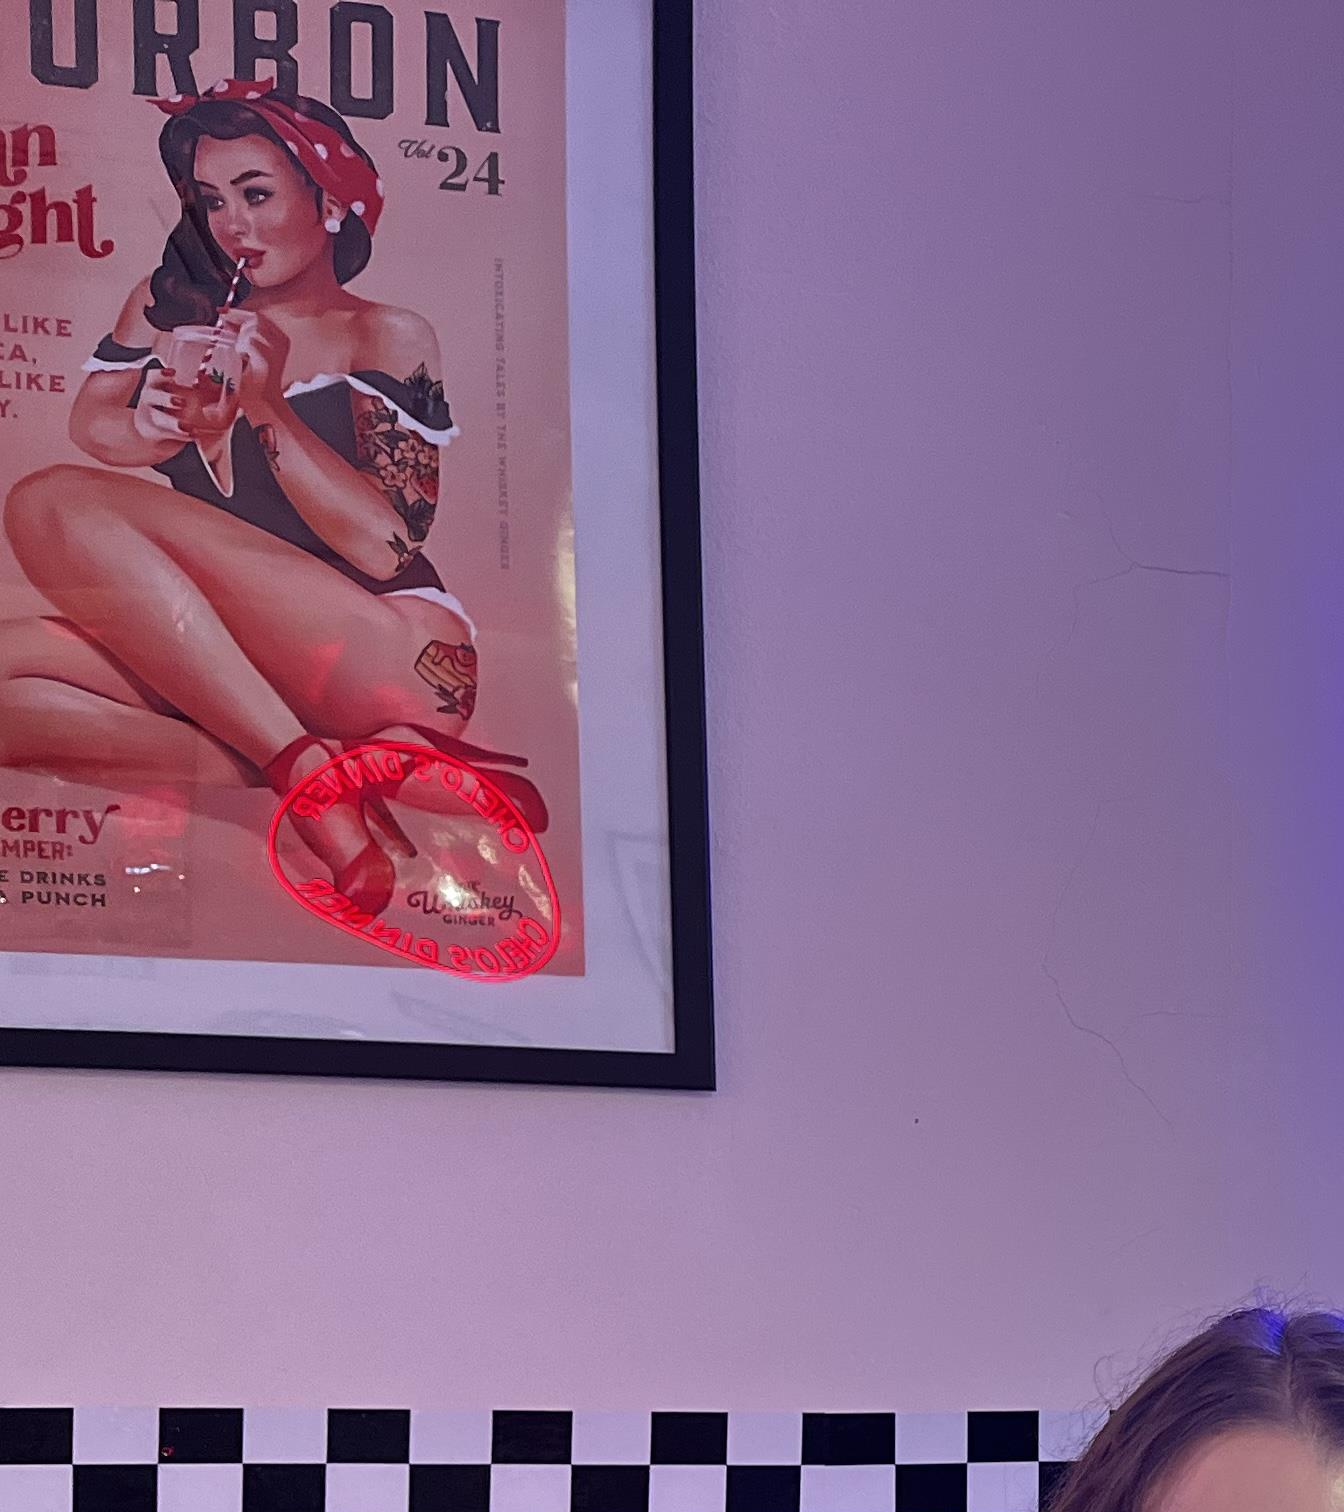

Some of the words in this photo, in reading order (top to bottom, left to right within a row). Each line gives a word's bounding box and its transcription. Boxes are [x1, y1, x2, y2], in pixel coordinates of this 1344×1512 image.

[398, 139, 435, 158] Vol
[437, 146, 505, 197] 24
[494, 257, 505, 352] INTOXICATING
[3, 313, 73, 338] LIKE
[0, 370, 65, 393] LIKE
[495, 357, 507, 397] TALES
[496, 424, 508, 449] THE
[2, 804, 121, 845] erry
[20, 870, 106, 886] DRINKS
[22, 891, 107, 907] PUNCH
